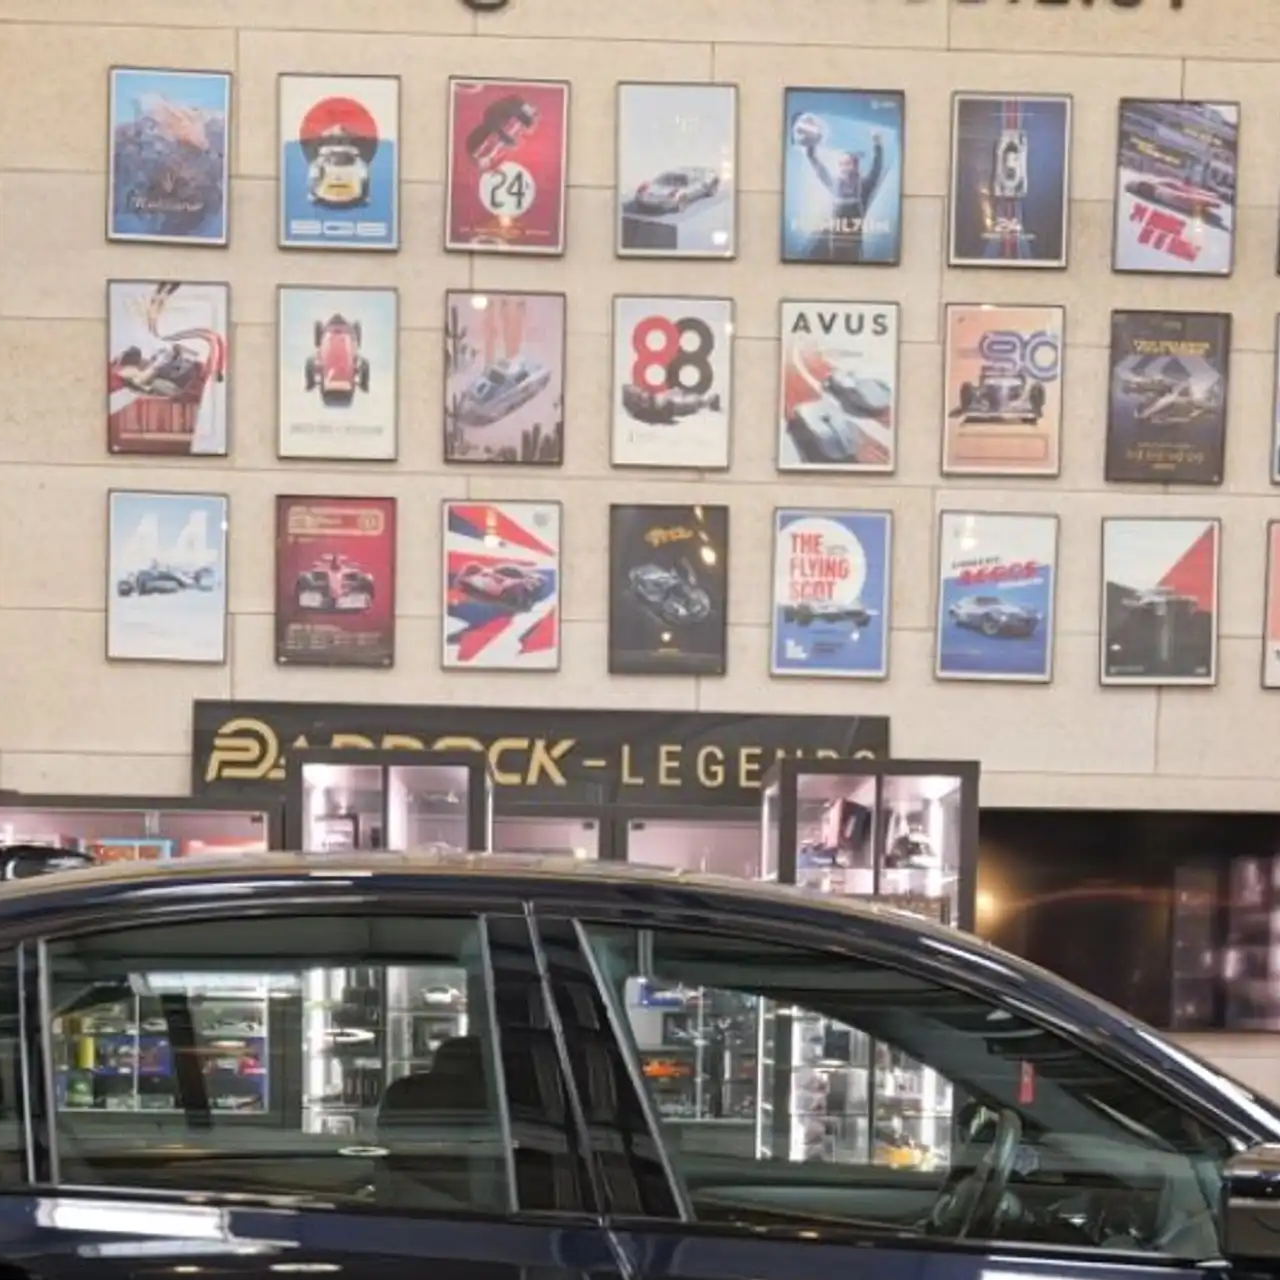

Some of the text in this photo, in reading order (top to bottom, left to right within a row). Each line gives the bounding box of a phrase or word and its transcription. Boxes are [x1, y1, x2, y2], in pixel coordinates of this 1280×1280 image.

[791, 311, 889, 336] AVUS
[632, 315, 715, 395] 88
[790, 532, 824, 555] THE
[789, 557, 850, 579] FLYING
[788, 581, 837, 603] SCOT
